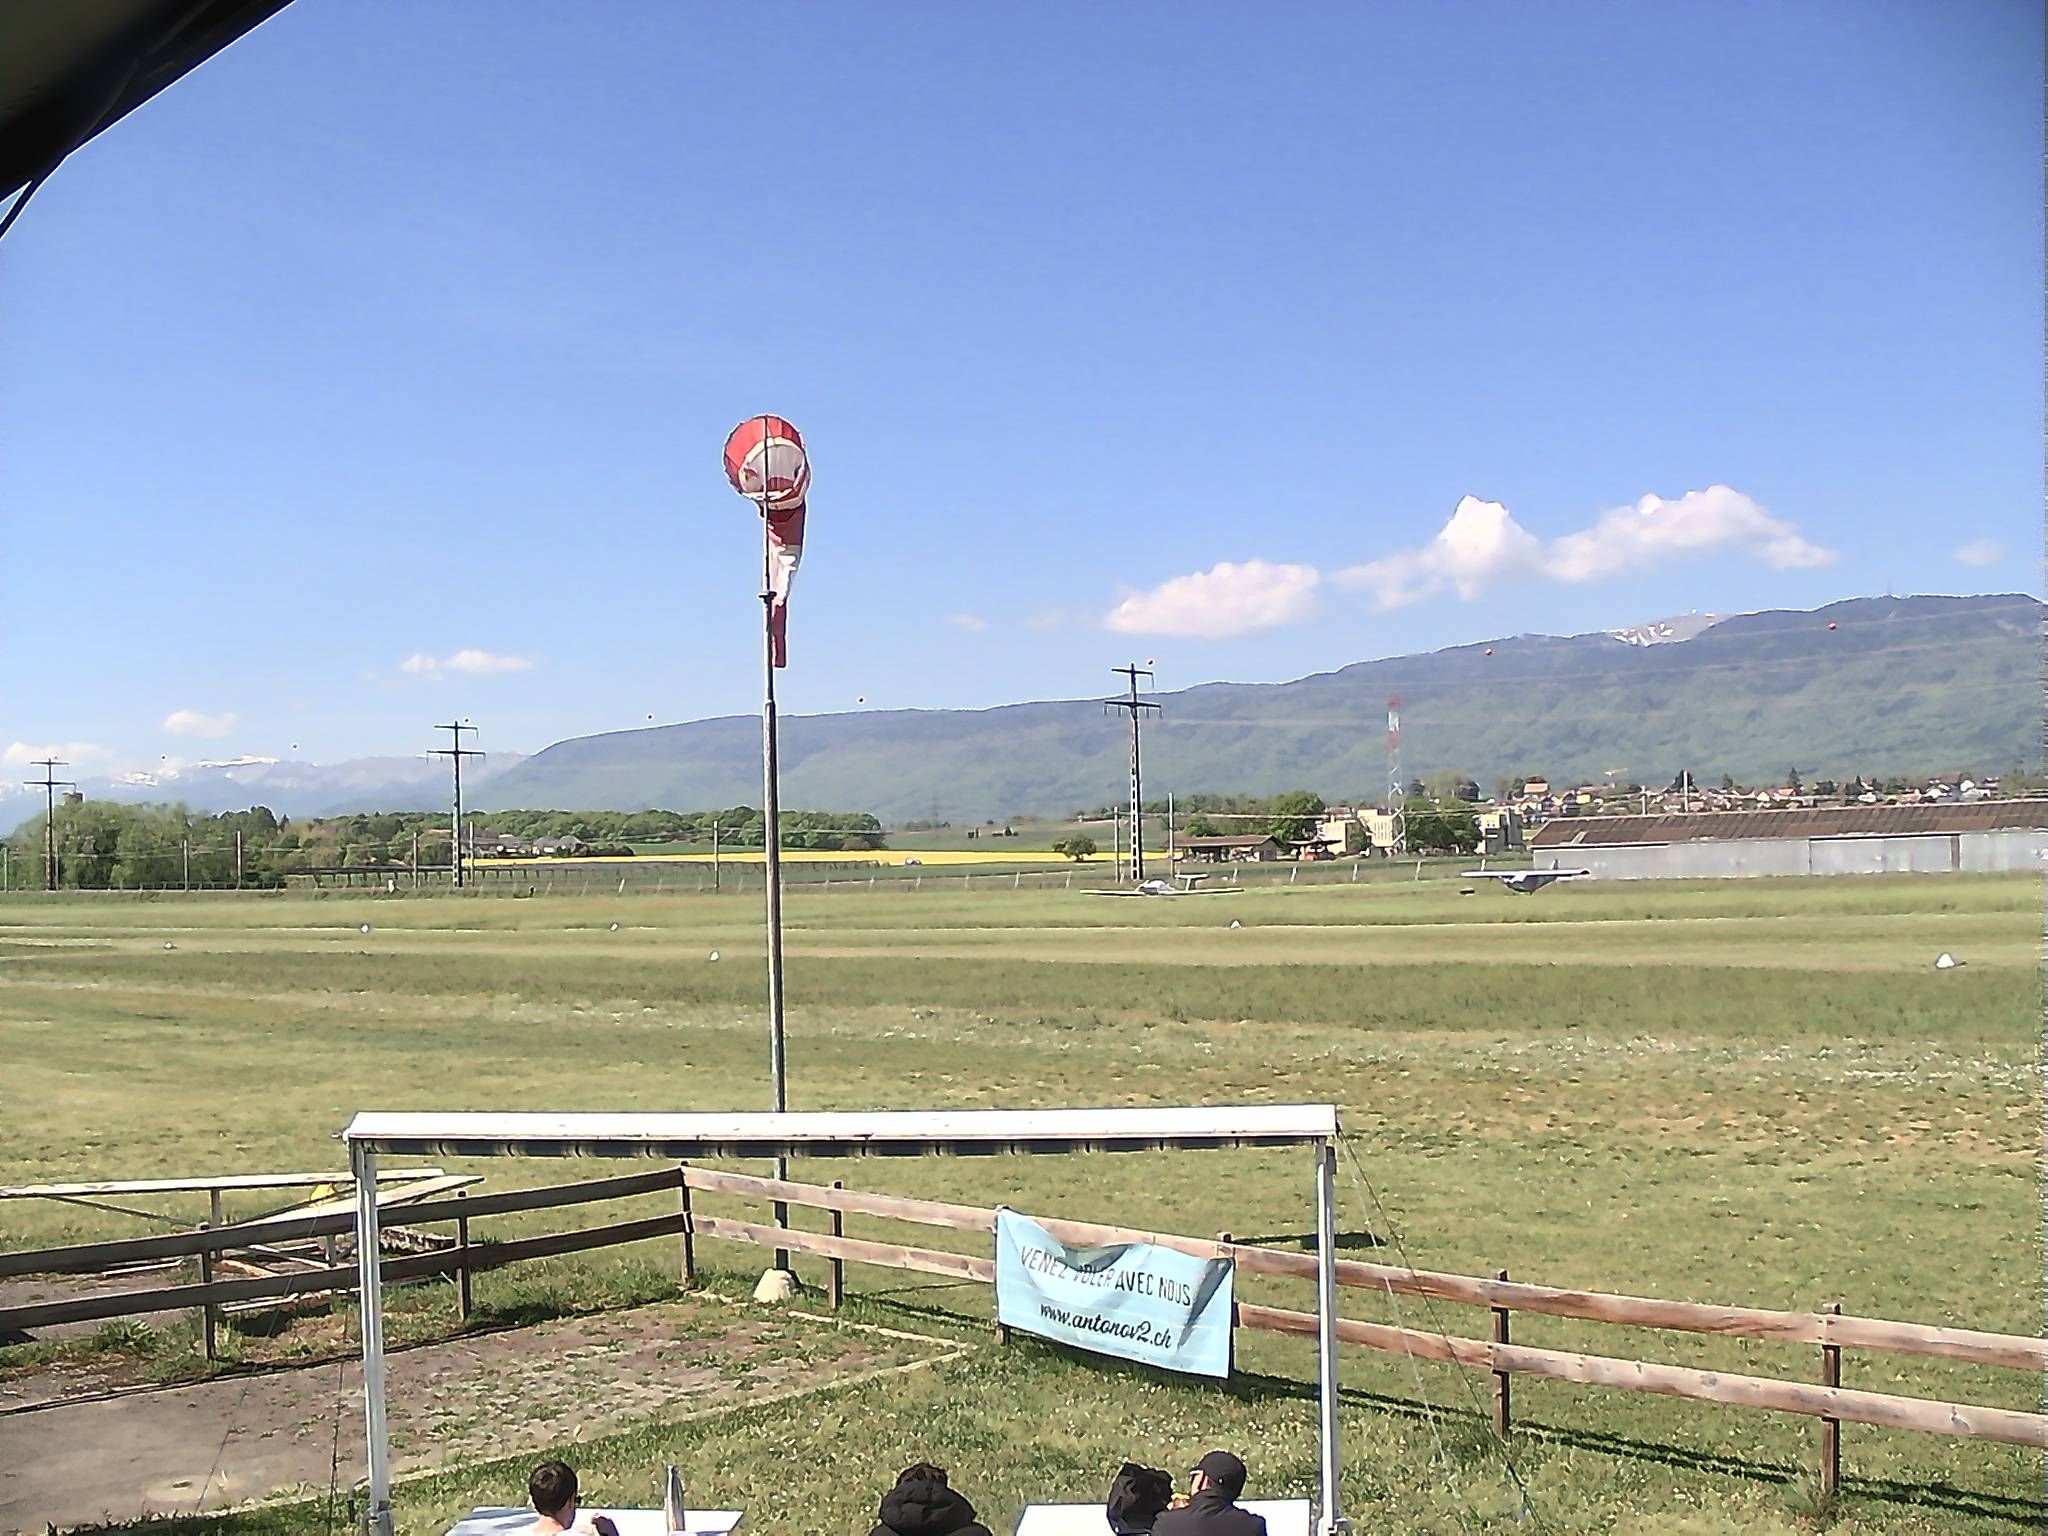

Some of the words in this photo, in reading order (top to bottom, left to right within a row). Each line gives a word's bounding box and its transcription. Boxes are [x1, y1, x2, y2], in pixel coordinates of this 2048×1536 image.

[1021, 1246, 1067, 1279] VENEZ
[1115, 1270, 1154, 1296] AVEC
[1158, 1277, 1191, 1306] NOUS
[1040, 1303, 1171, 1349] www.antonov2.ch
